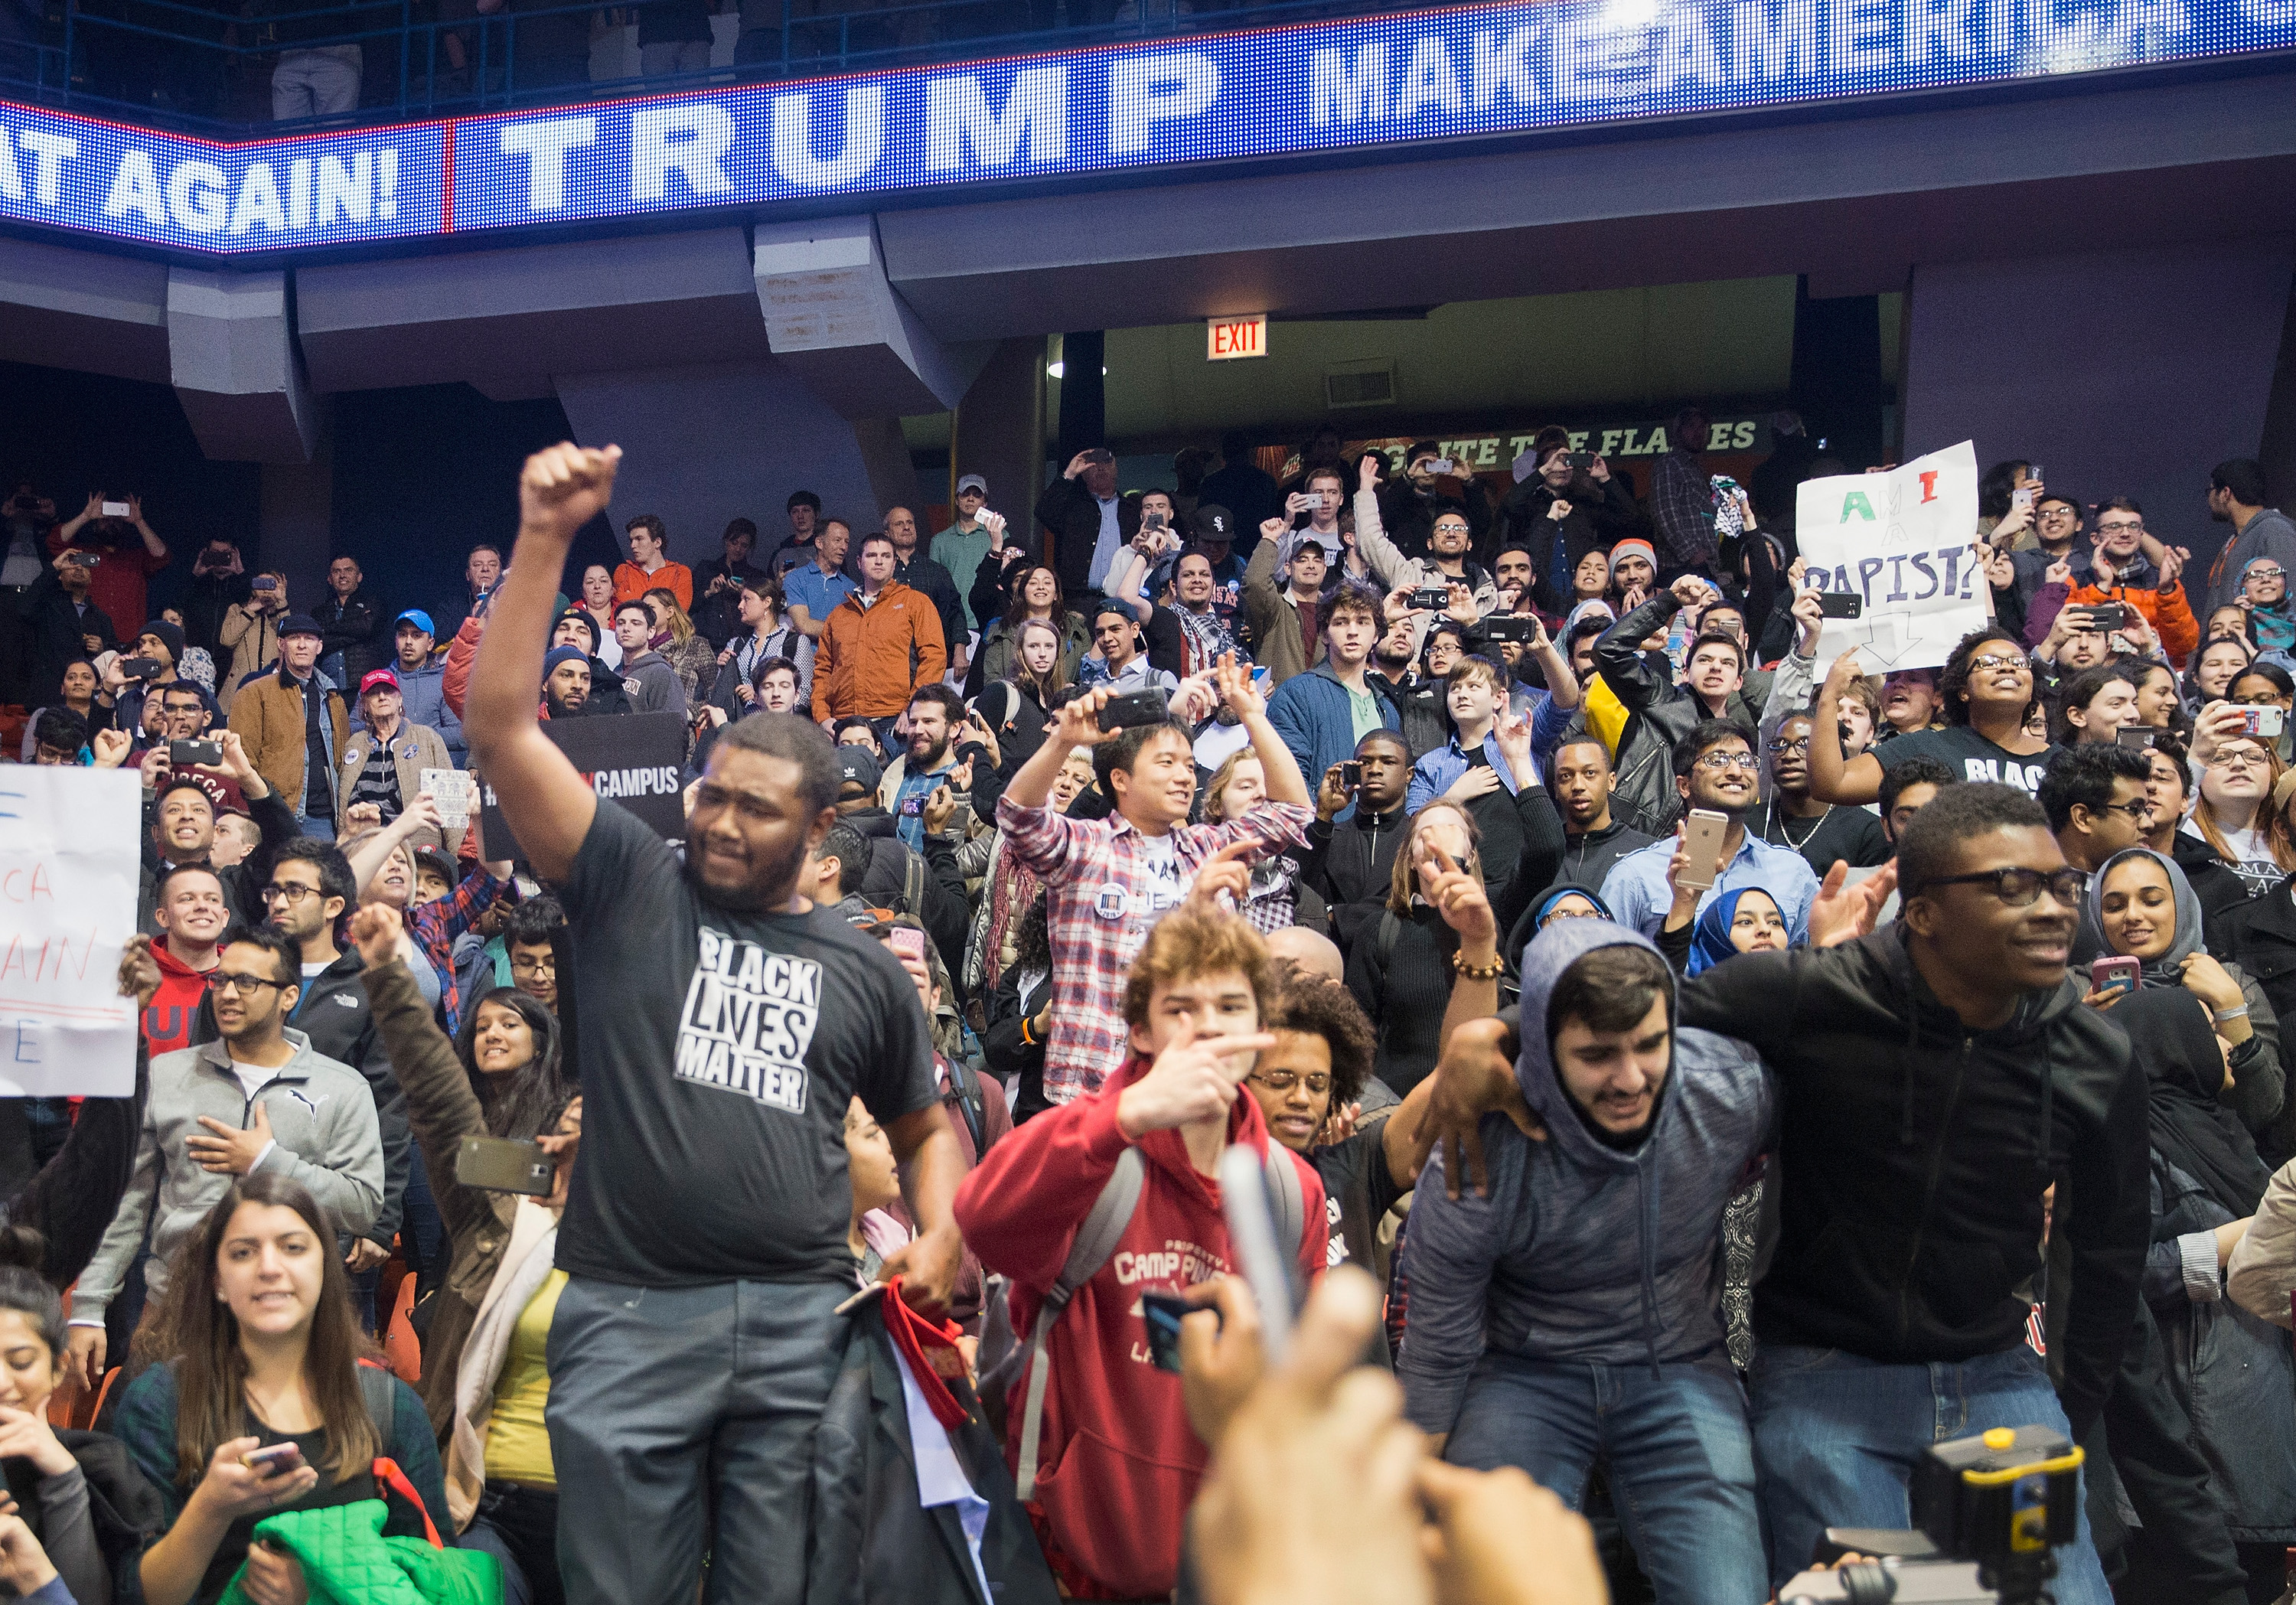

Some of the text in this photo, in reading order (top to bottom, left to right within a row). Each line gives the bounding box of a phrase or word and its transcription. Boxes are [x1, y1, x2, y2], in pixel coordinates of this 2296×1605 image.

[1309, 21, 1616, 129] MAKE
[499, 49, 1224, 211] TRUMP
[103, 147, 399, 236] AGAIN!
[1215, 321, 1260, 354] EXIT
[1367, 421, 1756, 472] GITE TE FLAES
[1919, 470, 1939, 505] I
[1881, 522, 1910, 546] A
[699, 931, 817, 1007] BLACK
[689, 976, 807, 1060] LIVES
[677, 1034, 803, 1109] MATTER
[1114, 1251, 1180, 1286] CAMP
